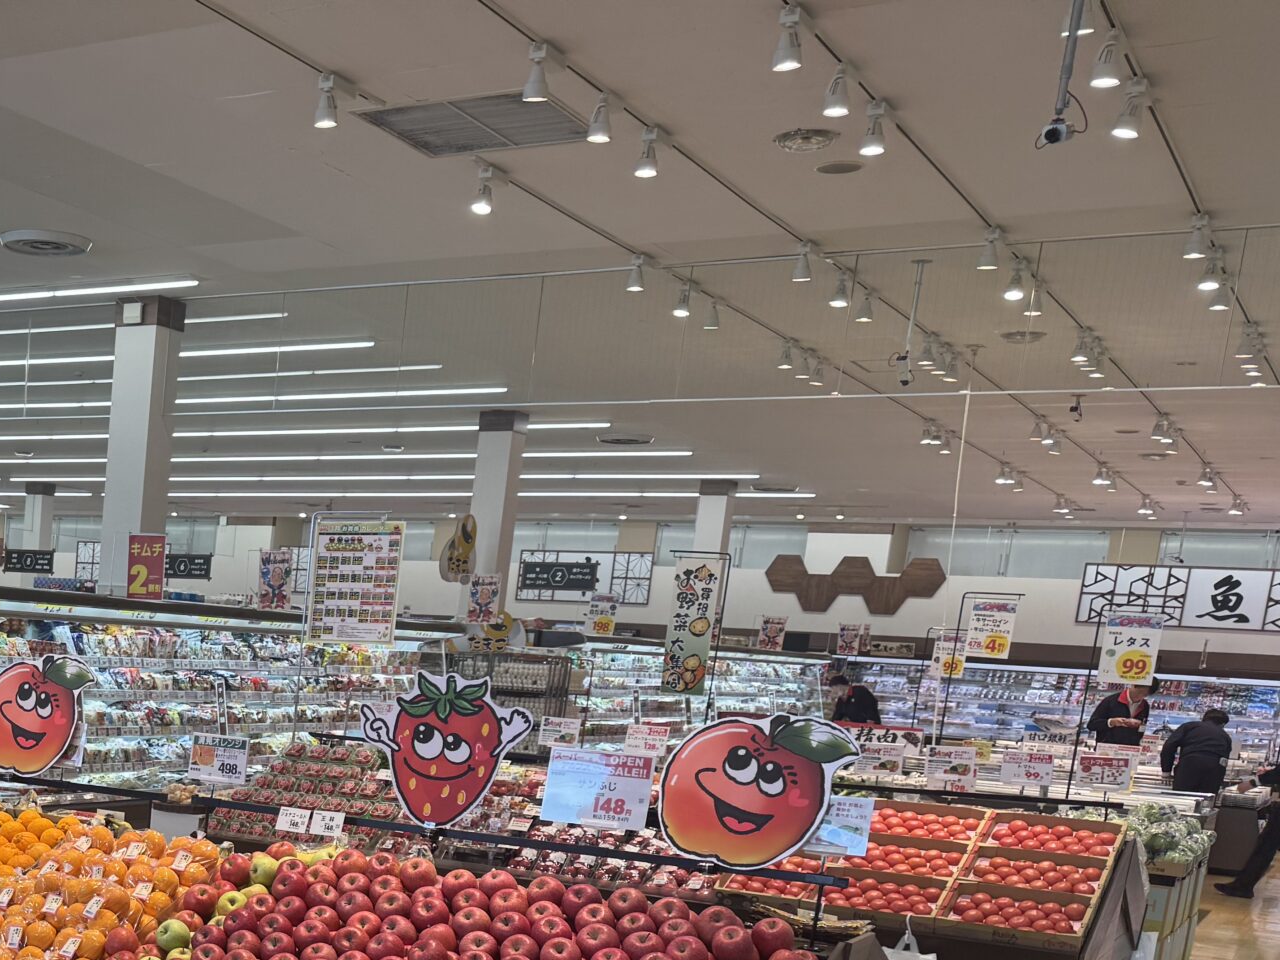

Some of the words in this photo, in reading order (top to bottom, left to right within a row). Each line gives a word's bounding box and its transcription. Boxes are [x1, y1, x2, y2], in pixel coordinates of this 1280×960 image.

[131, 542, 163, 557] キムチ
[180, 562, 185, 571] 6
[555, 571, 563, 581] 2
[1195, 574, 1251, 624] 魚
[592, 620, 610, 632] 198
[975, 617, 1009, 625] 牛サーロイン
[1113, 635, 1151, 648] レタス
[1122, 658, 1148, 676] 99
[855, 726, 899, 744] 精肉
[610, 755, 644, 767] OPEN
[609, 766, 647, 778] SALE!!
[1024, 771, 1041, 779] 99
[578, 779, 617, 791] サンふじ
